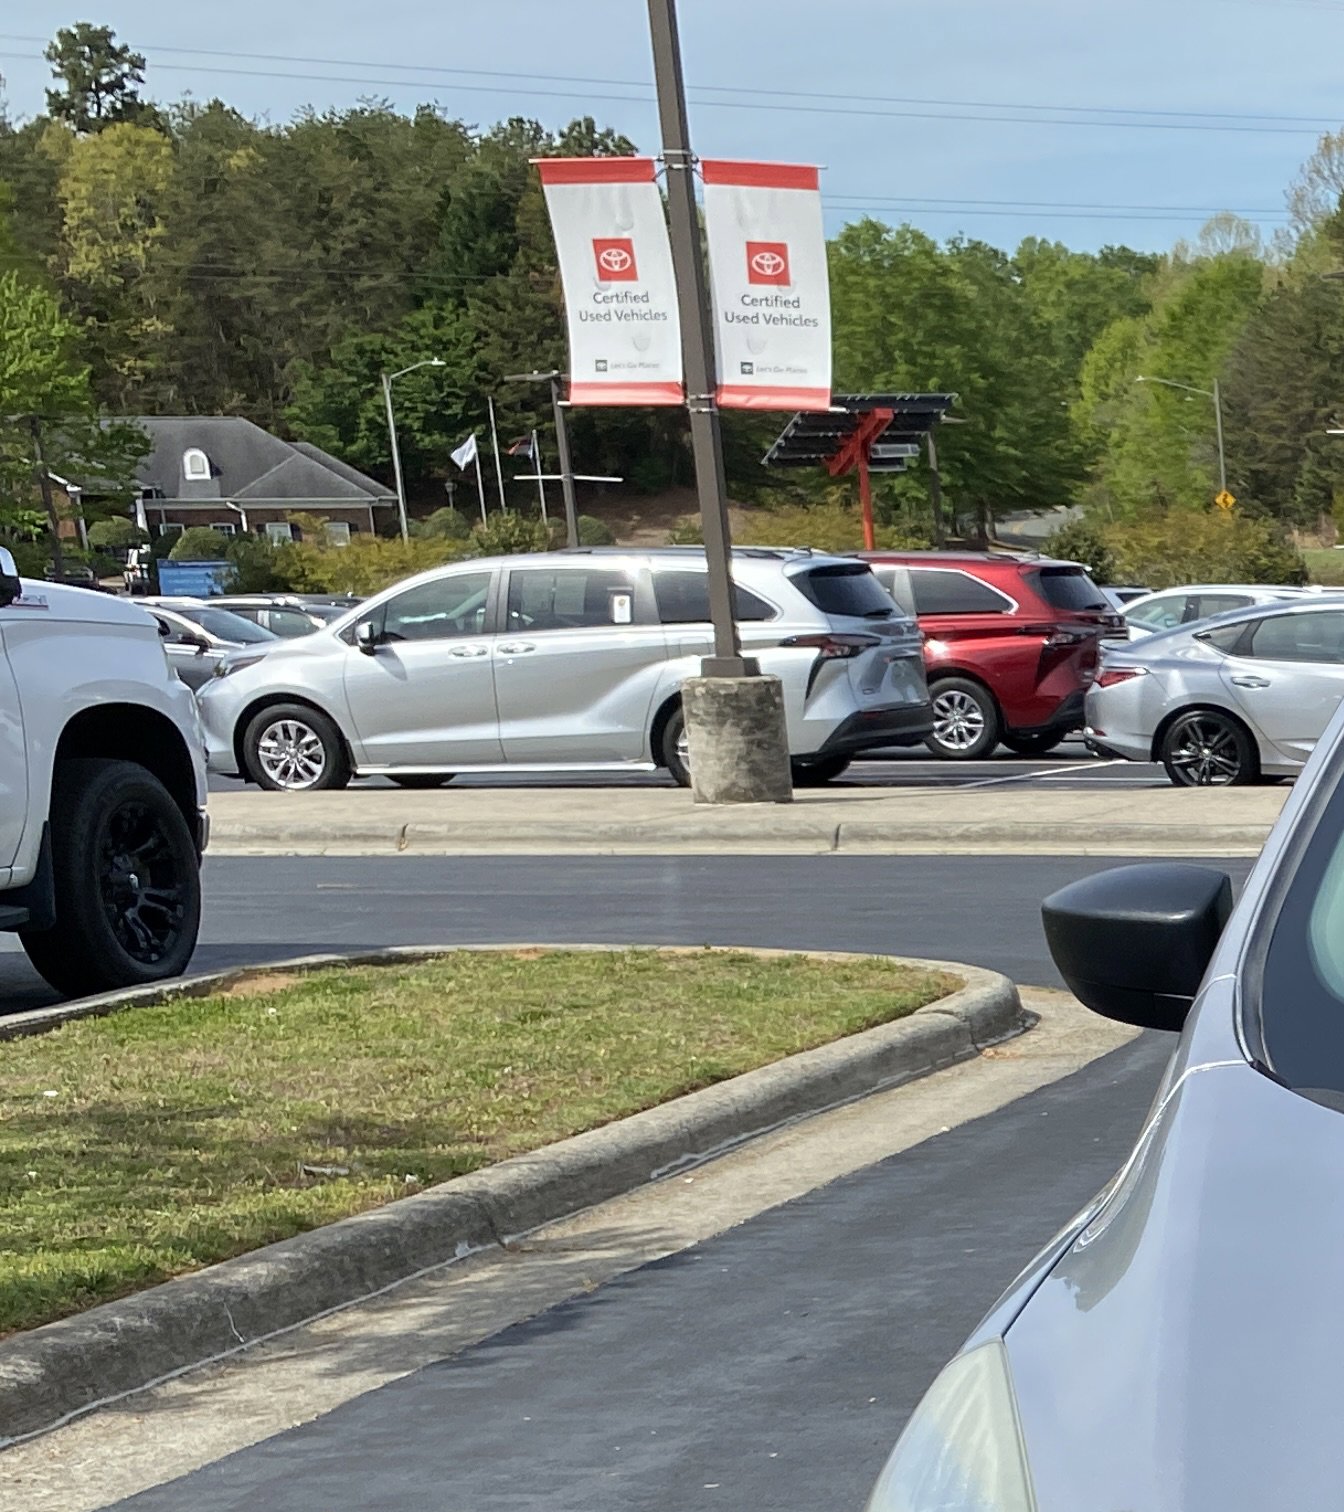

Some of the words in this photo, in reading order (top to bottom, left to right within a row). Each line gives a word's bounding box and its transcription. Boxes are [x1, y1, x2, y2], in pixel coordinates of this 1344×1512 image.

[593, 291, 650, 304] Certified
[741, 293, 801, 309] Certified
[579, 309, 612, 322] Used
[614, 308, 668, 321] Vehicles
[724, 311, 760, 324] Used
[762, 313, 819, 328] Vehicles
